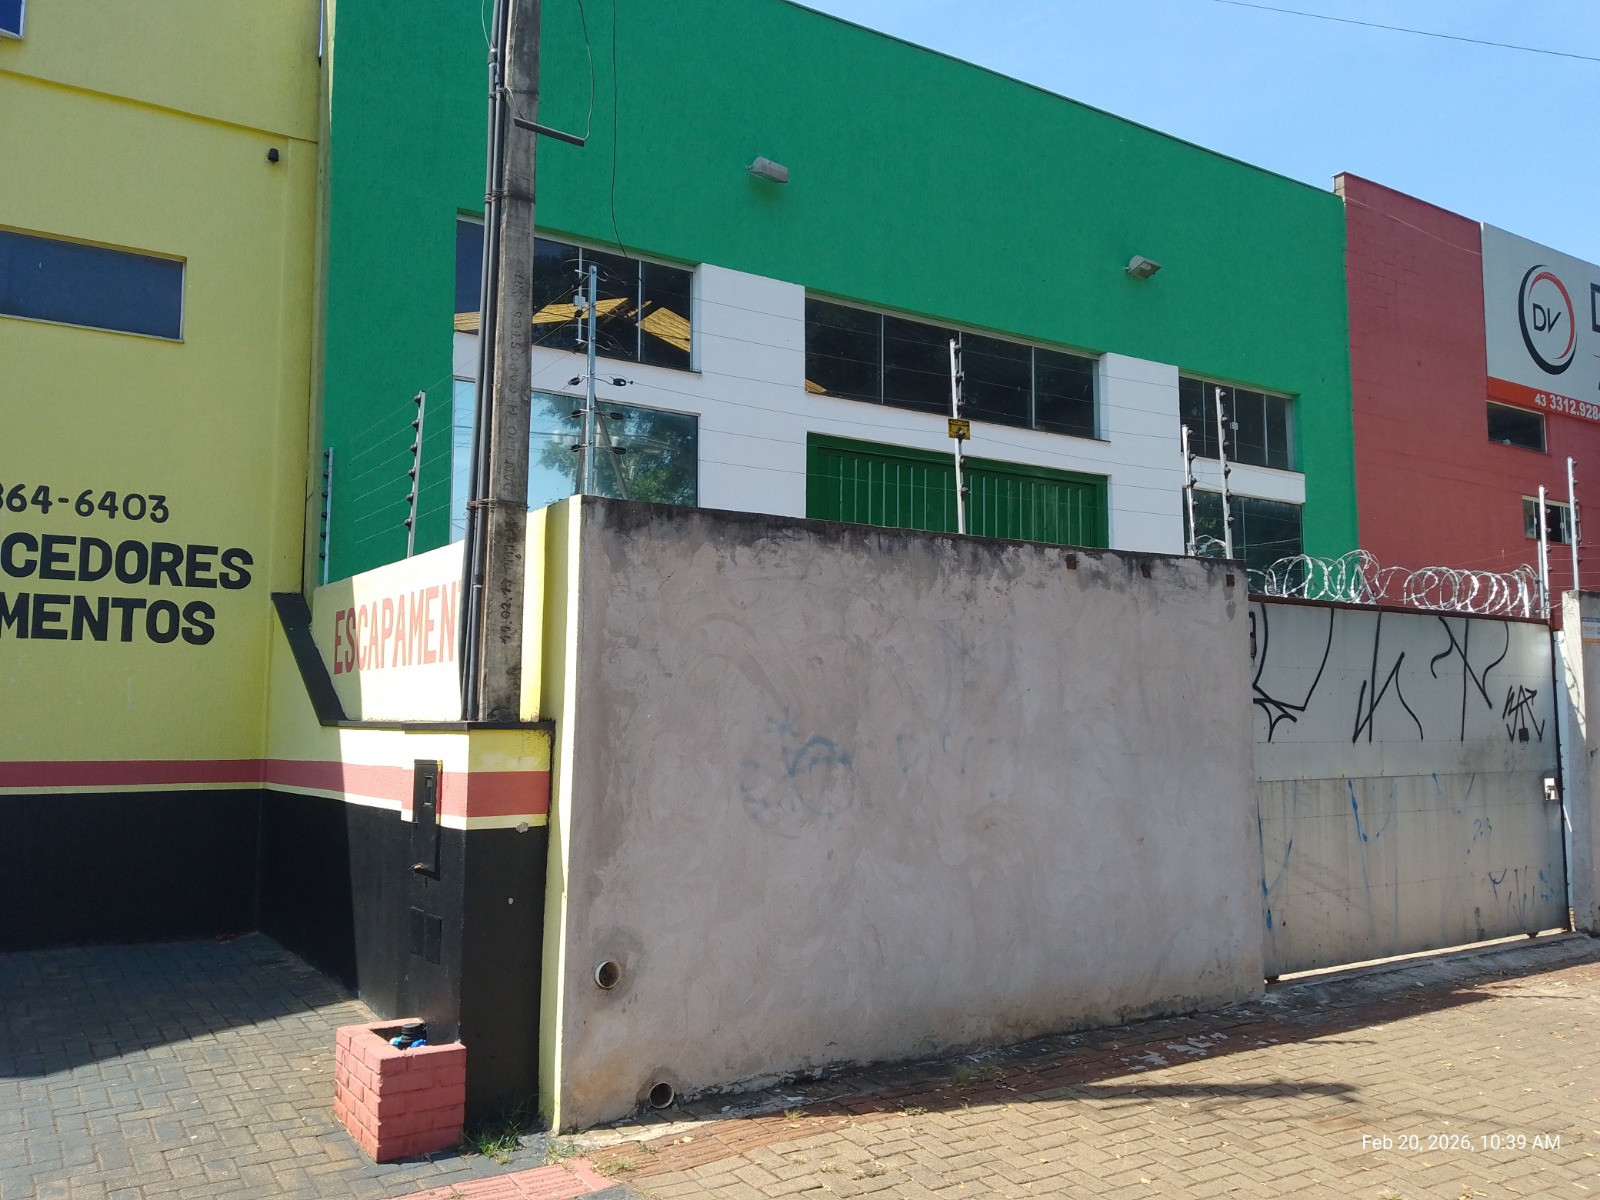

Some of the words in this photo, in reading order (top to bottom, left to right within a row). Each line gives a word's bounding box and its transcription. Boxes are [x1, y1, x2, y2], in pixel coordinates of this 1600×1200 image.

[1532, 302, 1562, 334] DV
[1535, 393, 1547, 407] 43
[1549, 394, 1600, 421] 3312.928
[0, 483, 170, 524] 64-6403
[0, 532, 254, 590] CEDORES
[0, 592, 216, 646] MENTOS
[334, 580, 462, 675] ESCAPAMEN
